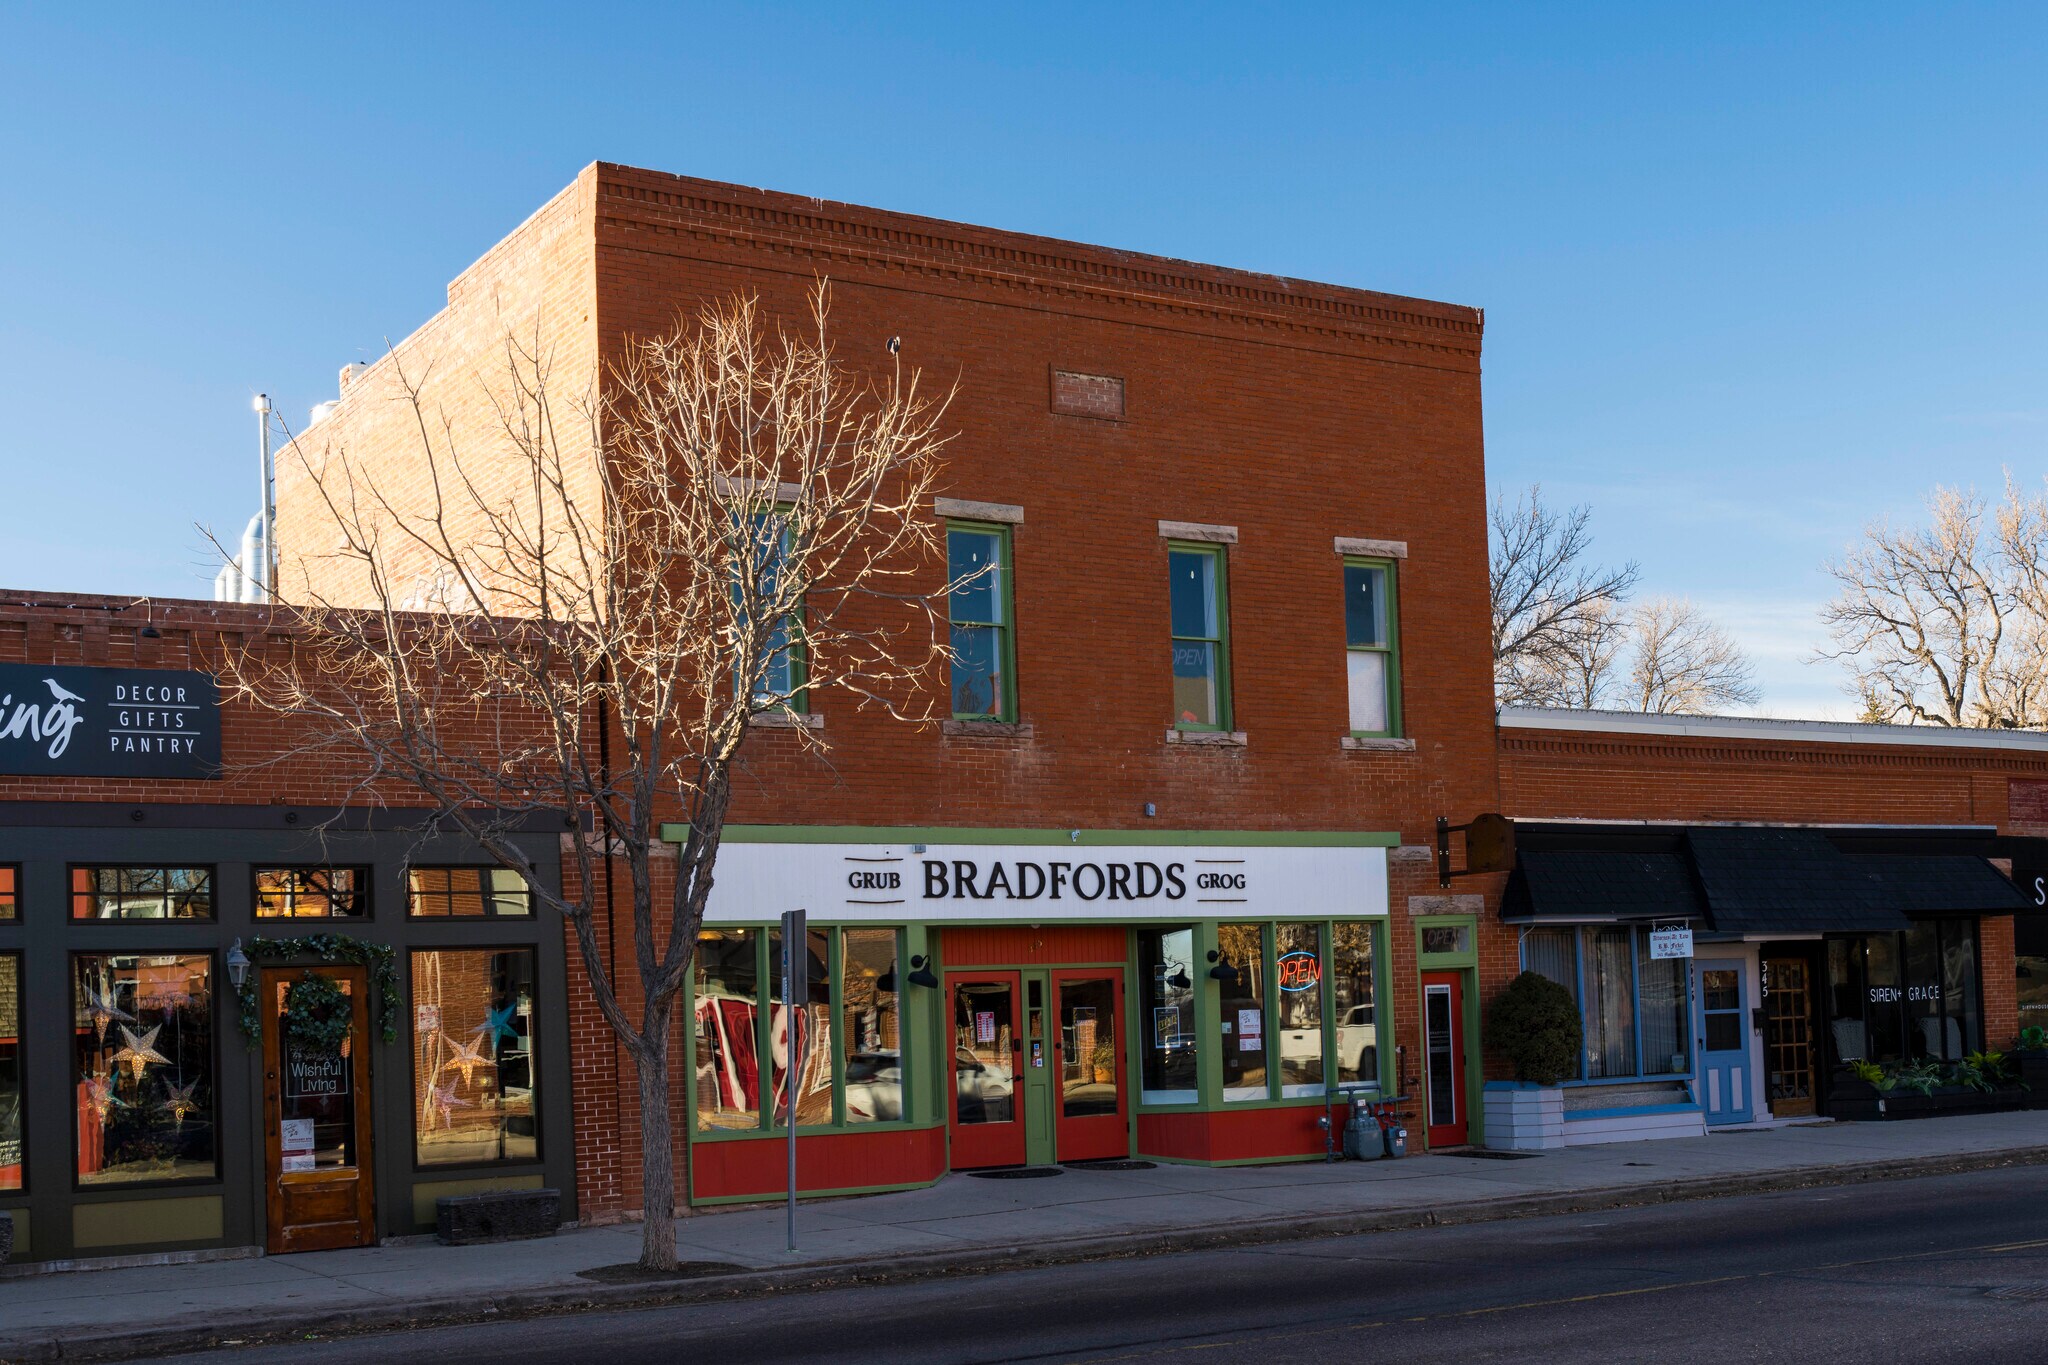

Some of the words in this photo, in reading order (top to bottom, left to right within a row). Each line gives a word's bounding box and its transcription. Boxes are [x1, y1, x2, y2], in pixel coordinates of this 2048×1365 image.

[116, 685, 186, 703] DECOR
[119, 711, 184, 728] GIFTS
[111, 737, 194, 754] PANTRY
[848, 871, 901, 889] GRUB
[922, 860, 1187, 900] BRADFORDS
[1196, 873, 1246, 889] GROG
[1761, 960, 1769, 998] 345
[1908, 985, 1940, 1001] GRACE
[290, 1060, 342, 1078] Wishful
[301, 1078, 337, 1093] Living
